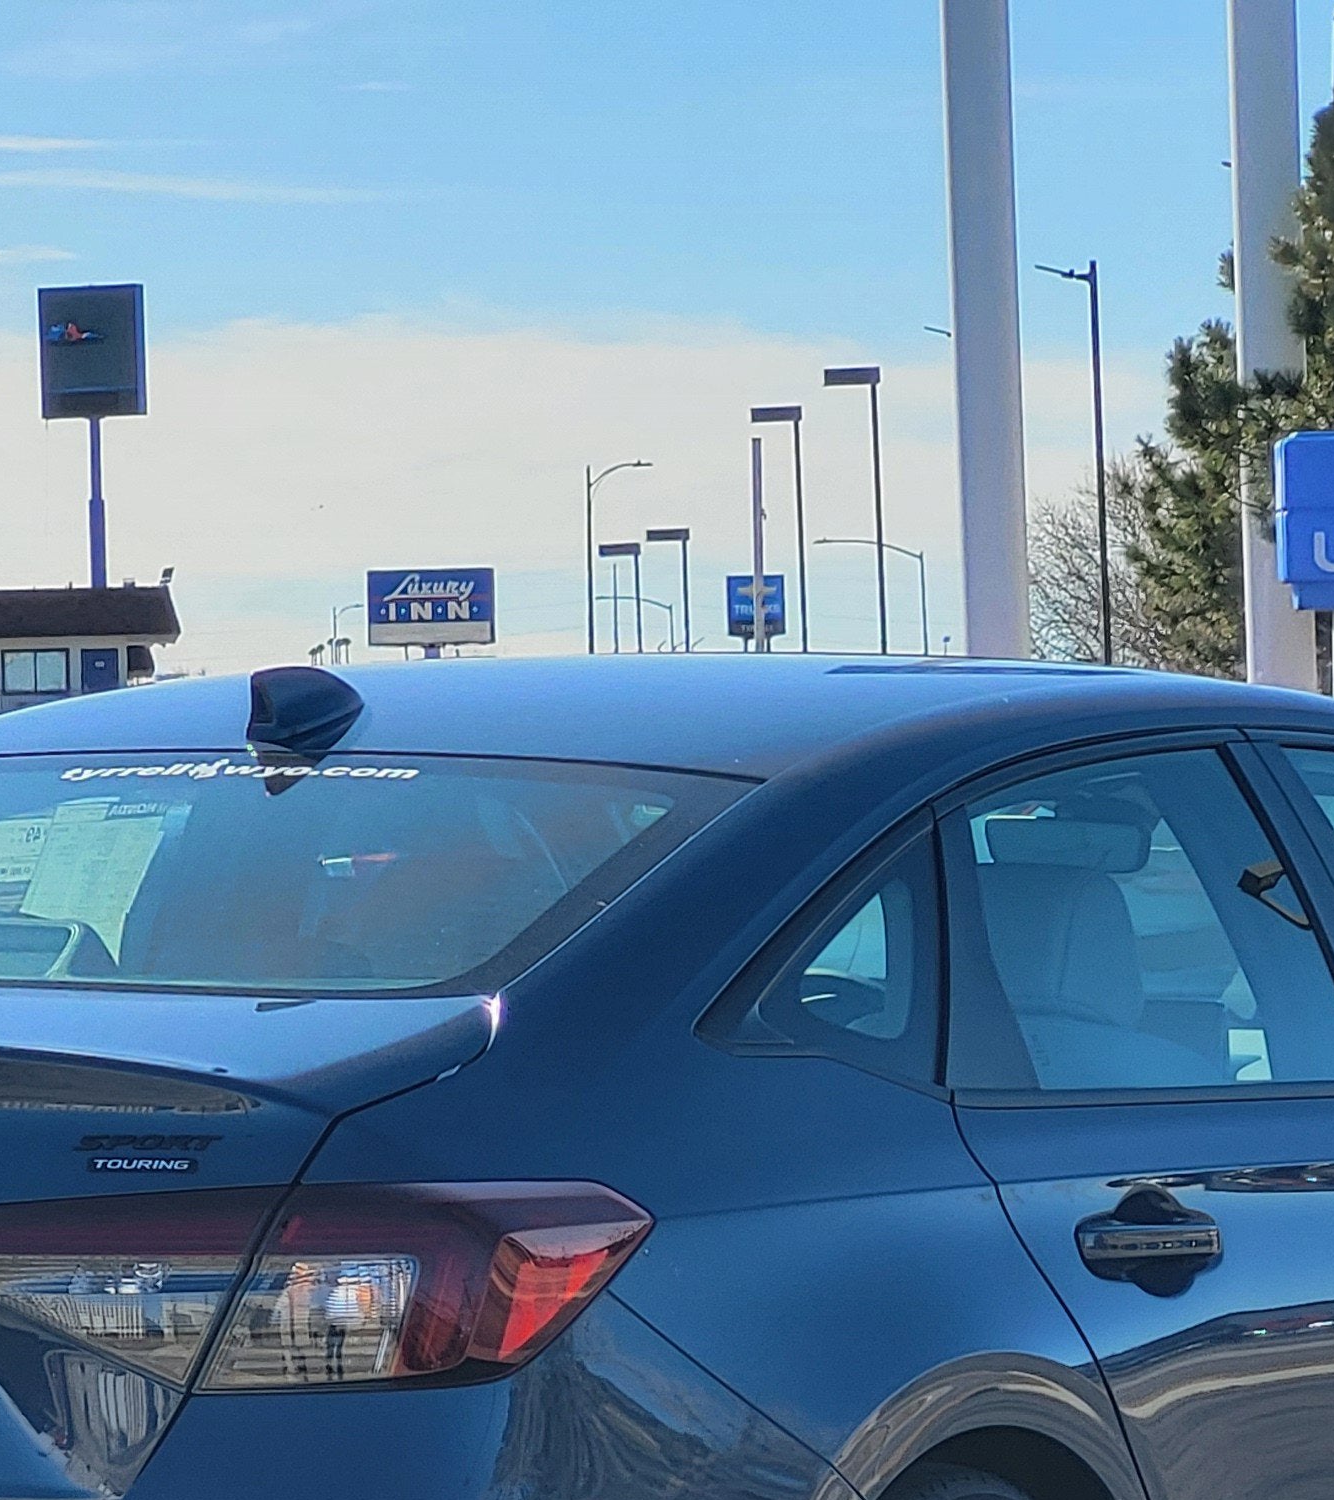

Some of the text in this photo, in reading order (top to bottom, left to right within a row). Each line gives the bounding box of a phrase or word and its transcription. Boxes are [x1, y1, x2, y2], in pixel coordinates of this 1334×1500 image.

[383, 573, 475, 602] Luxury
[73, 1134, 224, 1151] SPORT
[93, 1159, 191, 1170] TOURING
